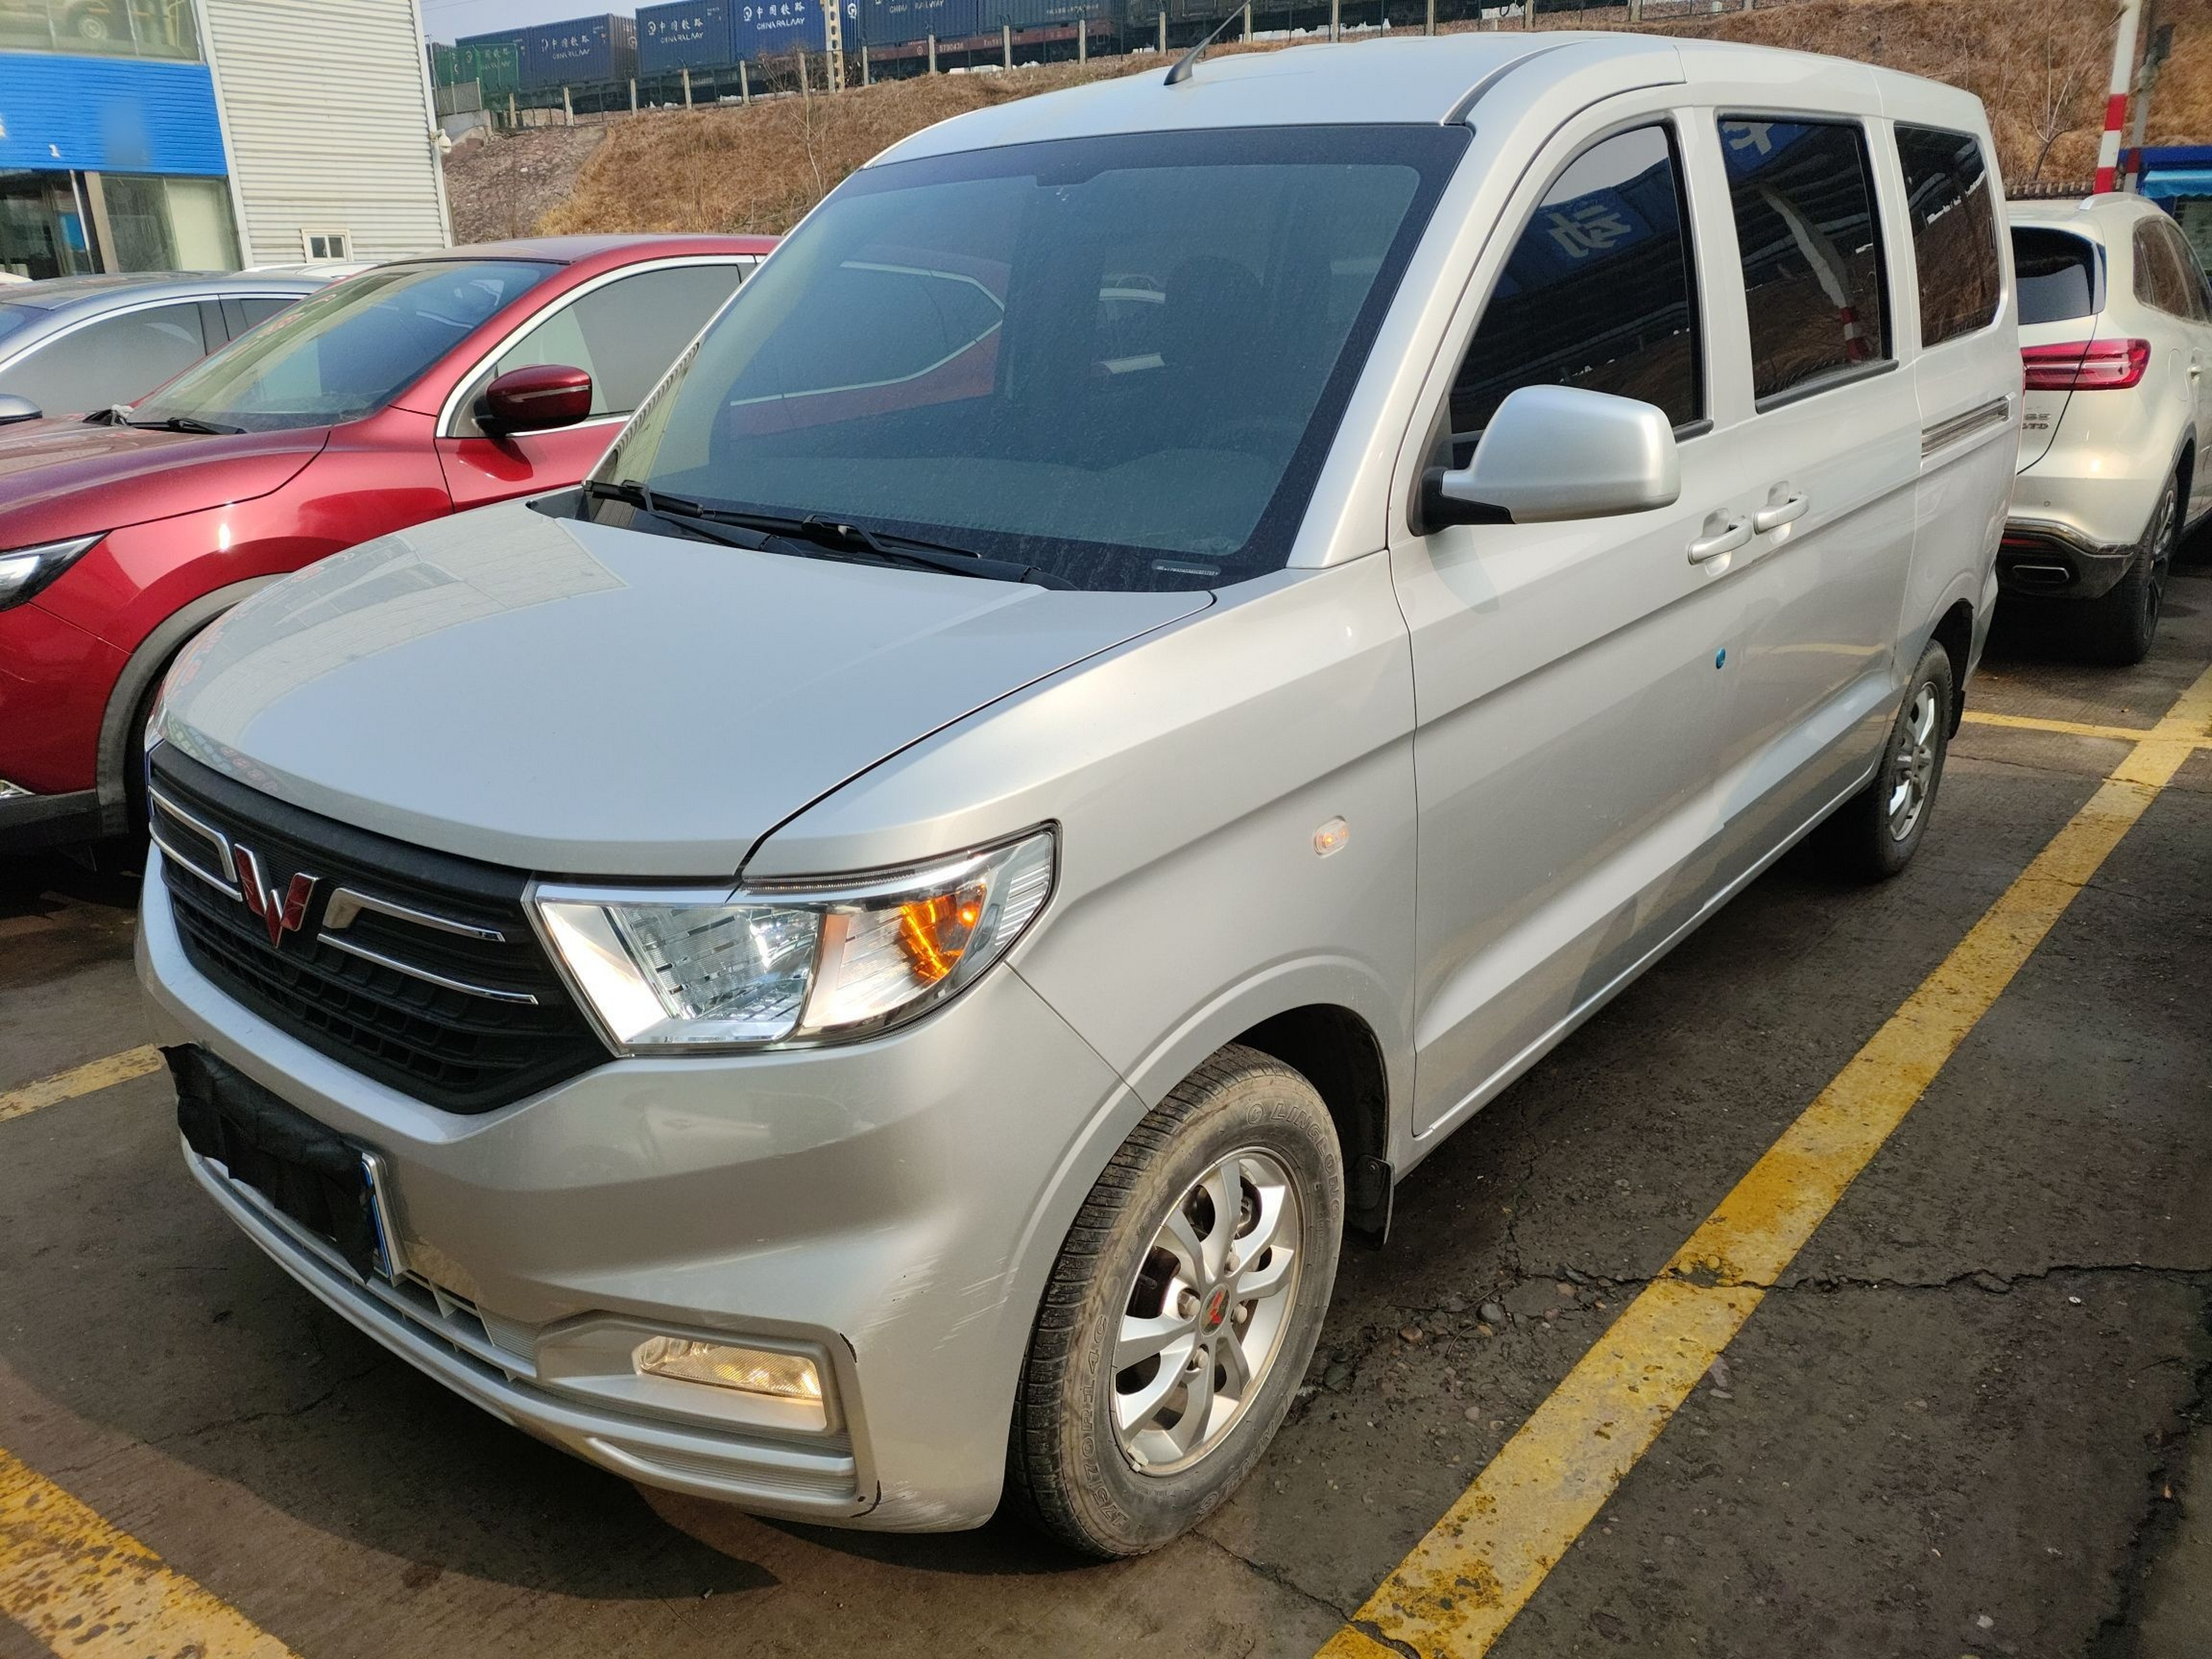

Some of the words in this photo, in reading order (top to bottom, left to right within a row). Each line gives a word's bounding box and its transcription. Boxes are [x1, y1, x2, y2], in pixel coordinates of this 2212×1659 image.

[660, 17, 703, 33] 中国铁路
[756, 2, 805, 20] 中国铁路
[1271, 1103, 1340, 1219] LINGLONG
[1080, 1314, 1128, 1528] 175/70R14C
